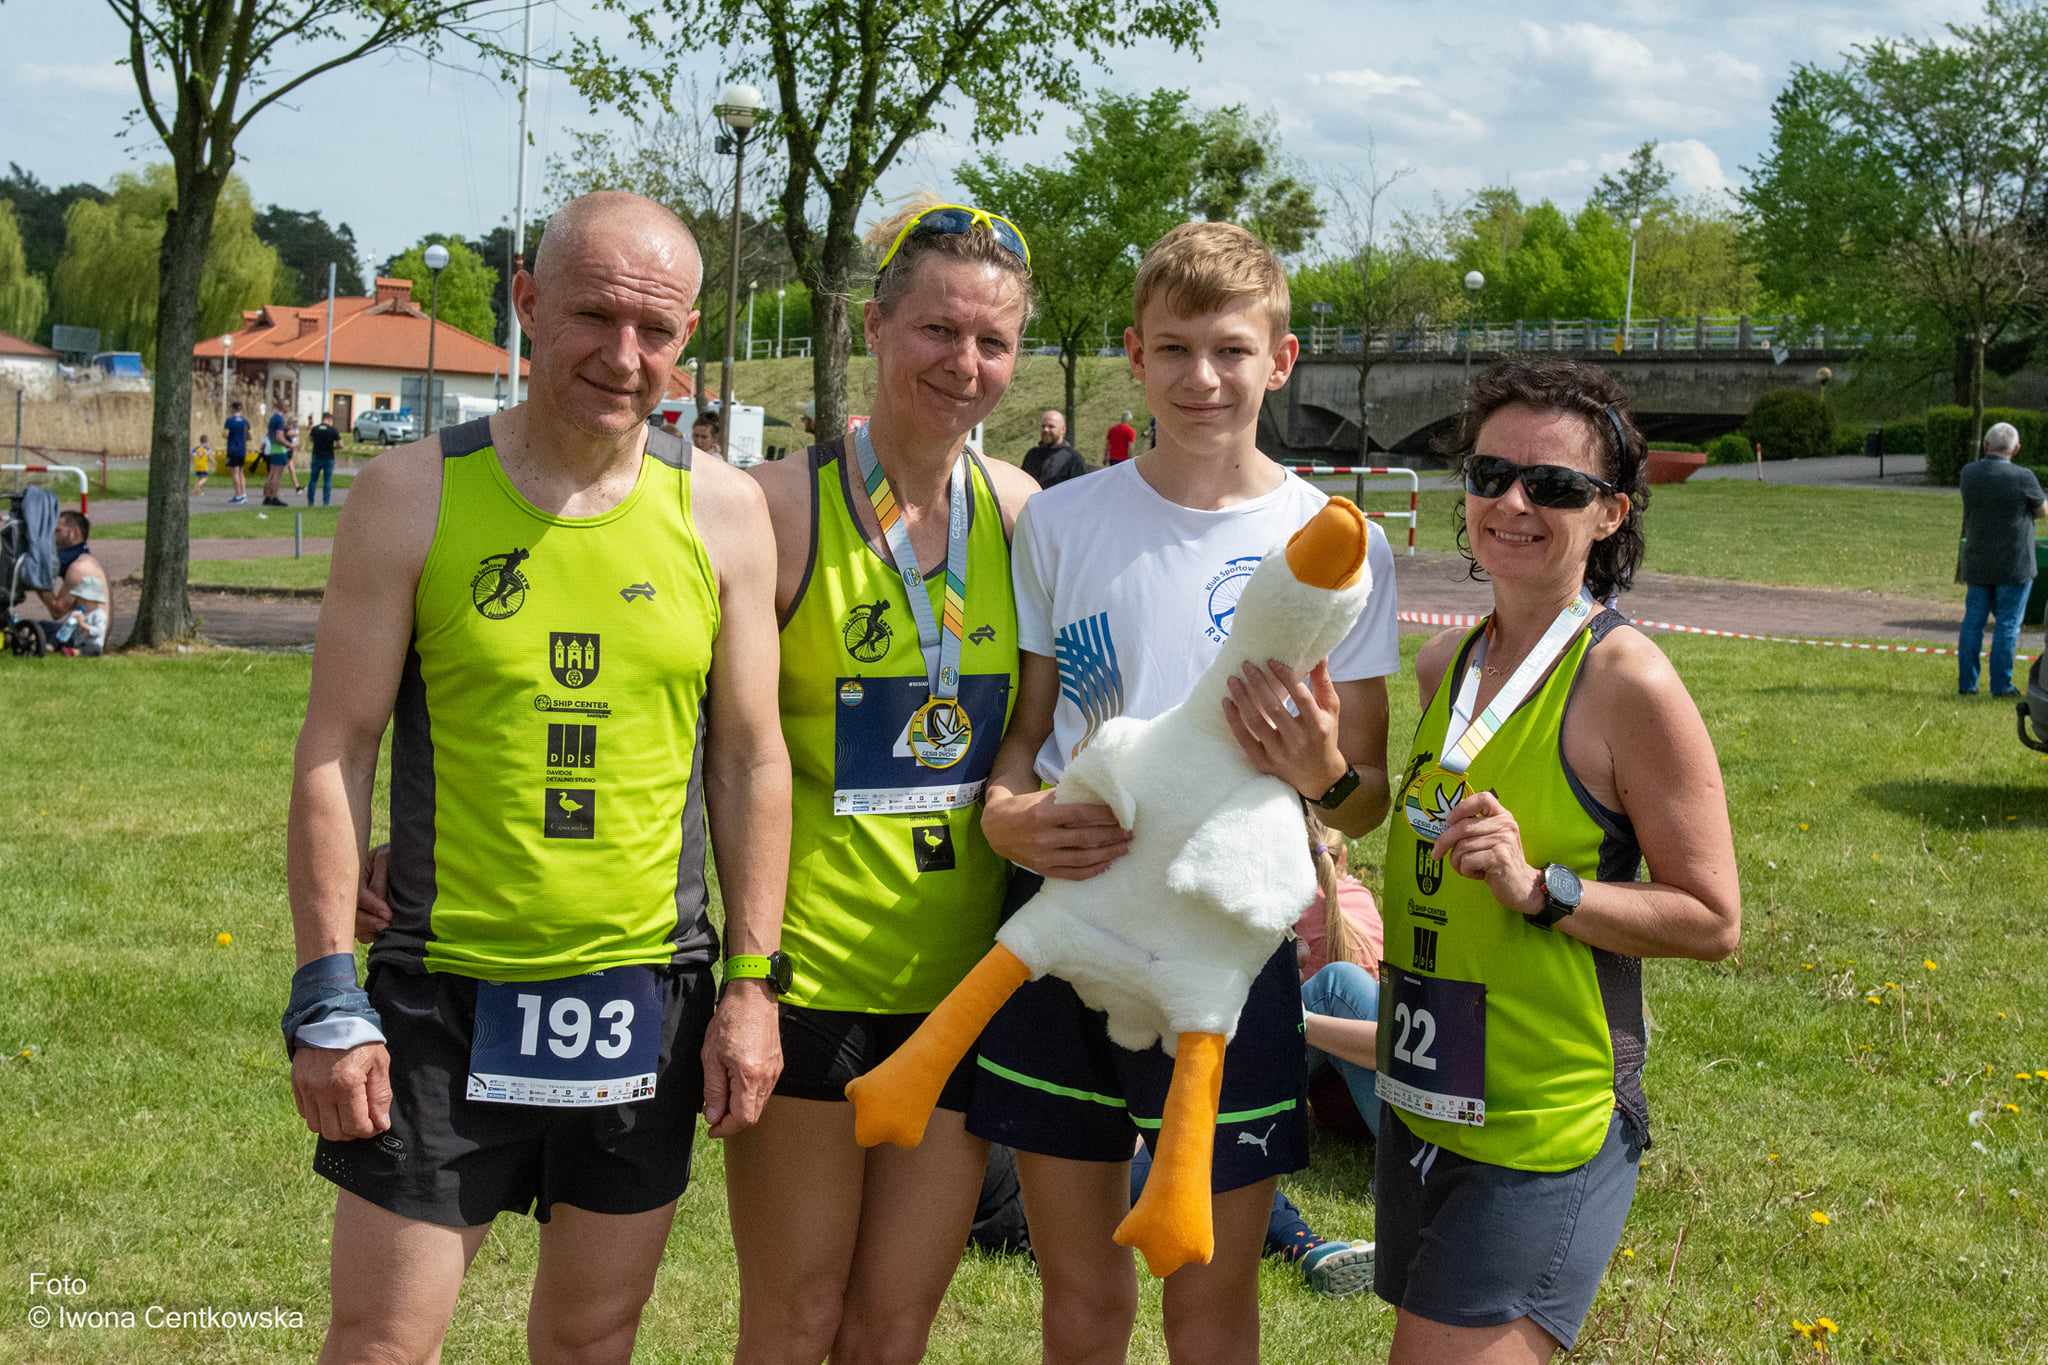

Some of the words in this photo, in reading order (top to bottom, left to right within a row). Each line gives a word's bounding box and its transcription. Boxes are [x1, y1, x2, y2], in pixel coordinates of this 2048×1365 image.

[1204, 575, 1221, 591] Klub
[1219, 565, 1255, 577] Sportow
[1204, 626, 1226, 645] Ra
[552, 699, 573, 708] SHIP
[574, 700, 608, 709] CENTER
[517, 993, 635, 1059] 193
[1394, 1002, 1437, 1071] 22
